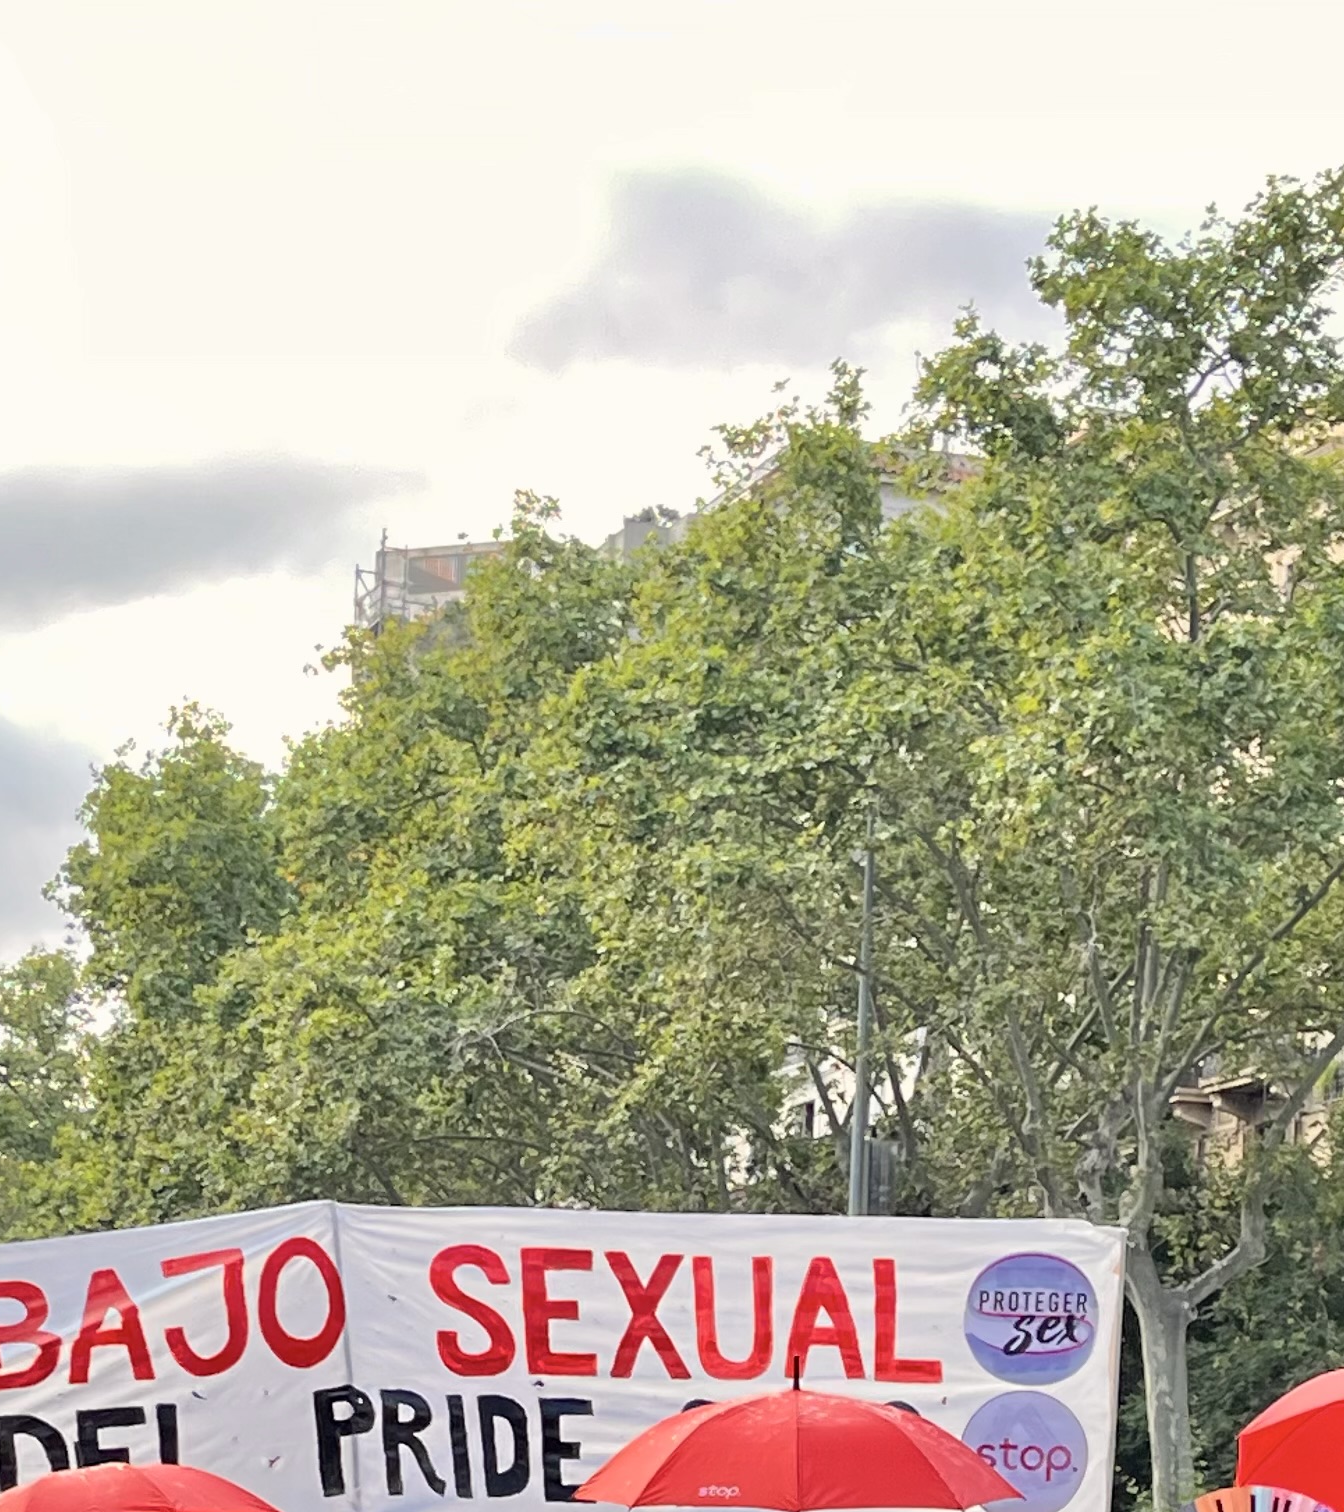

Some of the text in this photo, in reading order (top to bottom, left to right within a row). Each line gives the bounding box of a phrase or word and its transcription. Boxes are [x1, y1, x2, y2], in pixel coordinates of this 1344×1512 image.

[429, 1243, 943, 1383] SEXUAL
[978, 1289, 1088, 1314] PROTEGER
[1003, 1314, 1086, 1356] sex
[313, 1384, 596, 1504] PRIDE
